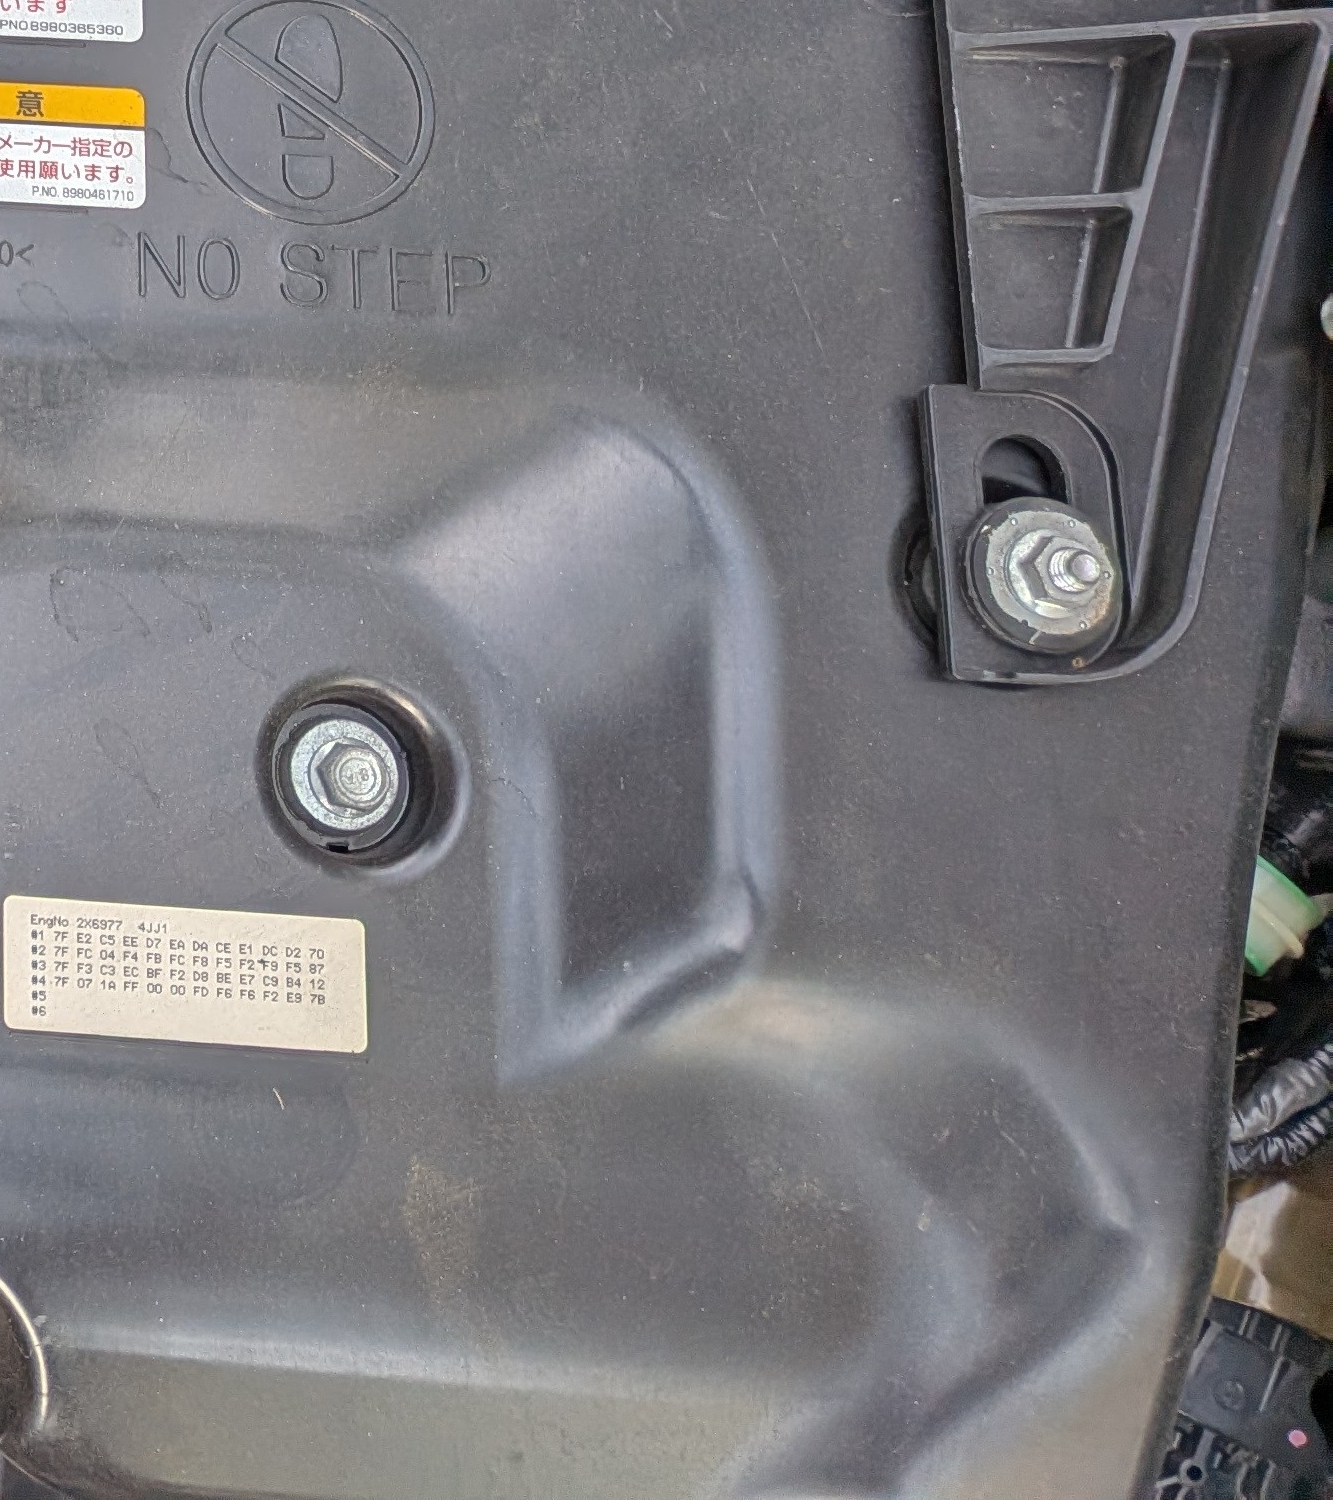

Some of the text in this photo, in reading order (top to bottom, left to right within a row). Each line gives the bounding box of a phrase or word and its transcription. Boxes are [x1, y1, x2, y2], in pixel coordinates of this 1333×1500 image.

[137, 232, 491, 315] NO STEP
[77, 918, 122, 930] 2X6977
[138, 922, 166, 933] 4JJ1
[54, 932, 68, 941] 7F
[77, 933, 92, 944] E2
[123, 936, 138, 947] EE
[146, 938, 161, 948] D7
[170, 939, 185, 950] EA
[193, 941, 208, 951] DA
[216, 942, 231, 953] CE
[239, 944, 252, 955] E1
[263, 946, 277, 956] DC
[286, 947, 301, 958] D2
[54, 947, 68, 957] 7F
[77, 948, 92, 959] FC
[123, 951, 138, 962] F4
[170, 954, 185, 965] FC
[240, 959, 254, 970] F2
[262, 961, 278, 971] F9
[54, 962, 69, 972] 7F
[77, 963, 92, 974] F3
[100, 965, 115, 976] C3
[124, 966, 138, 977] EC
[170, 970, 185, 980] F2
[240, 974, 255, 985] E7
[263, 976, 278, 987] C9
[310, 979, 325, 990] 12
[55, 977, 69, 987] 7F
[101, 980, 116, 990] 1A
[124, 982, 138, 991] FF
[194, 986, 209, 997] FD
[217, 988, 232, 998] F6
[240, 989, 255, 1000] F6
[263, 991, 278, 1002] F2
[287, 992, 302, 1003] E9
